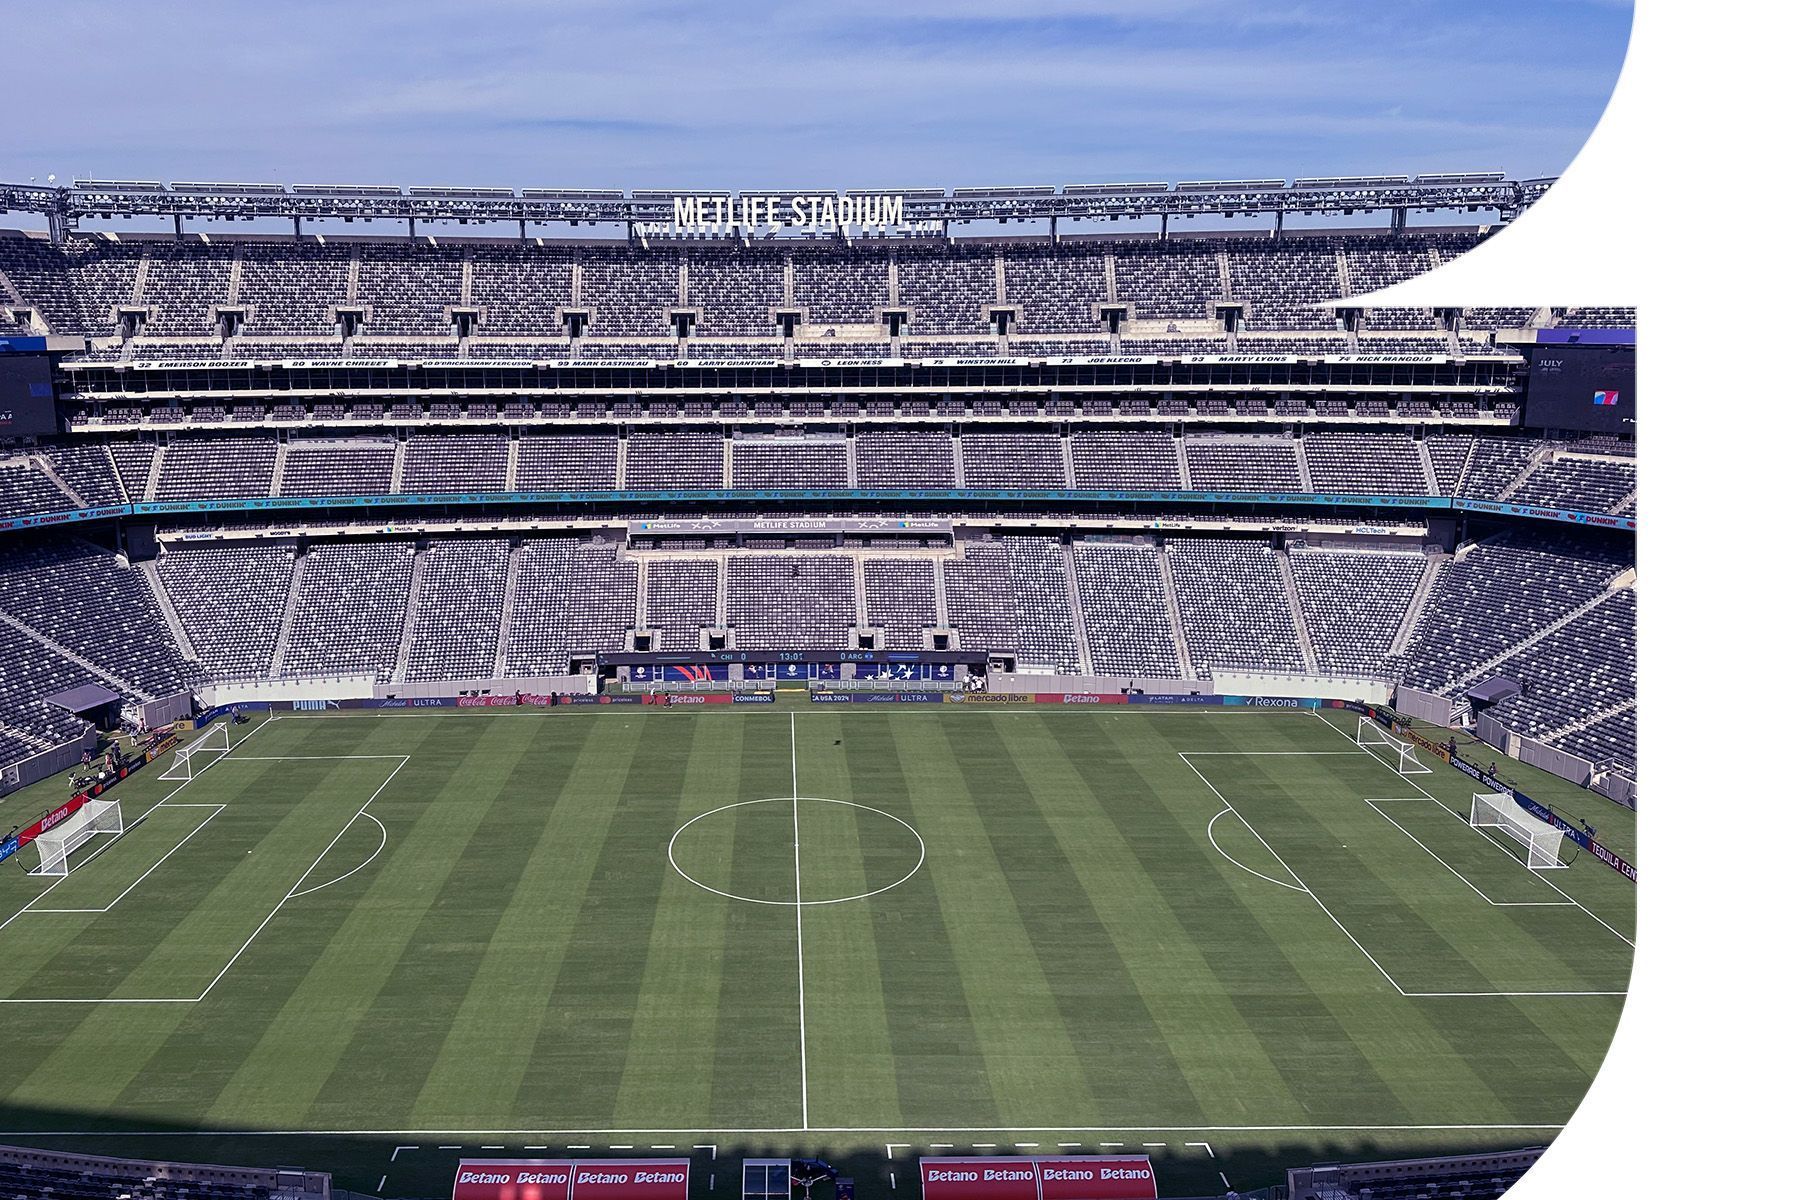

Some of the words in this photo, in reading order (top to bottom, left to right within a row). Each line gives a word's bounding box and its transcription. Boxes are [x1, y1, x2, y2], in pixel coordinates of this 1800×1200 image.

[673, 195, 782, 227] METLIFE
[790, 195, 903, 226] STADIUM
[96, 508, 126, 516] DUNKIN'
[1473, 503, 1503, 511] DUNKIN'
[40, 514, 71, 523] DUNKIN'
[1529, 509, 1561, 518] DUNKIN'
[1586, 516, 1618, 525] DUNKIN'
[670, 695, 704, 704] Betano
[1064, 694, 1100, 704] Betano
[1255, 696, 1298, 707] Rexona
[1408, 731, 1431, 750] mercado
[1432, 746, 1445, 759] libre
[1450, 756, 1480, 779] POWERADE
[42, 807, 68, 831] Betano
[1554, 818, 1575, 840] ULTRA
[1592, 842, 1619, 870] TEQUILA
[459, 1172, 510, 1184] Betano
[516, 1172, 568, 1184] Betano
[577, 1172, 628, 1184] Betano
[634, 1172, 685, 1183] Betano
[928, 1170, 978, 1182] Betano
[984, 1169, 1034, 1181] Betano
[1043, 1168, 1094, 1180] Betano
[1100, 1168, 1150, 1180] Betano
